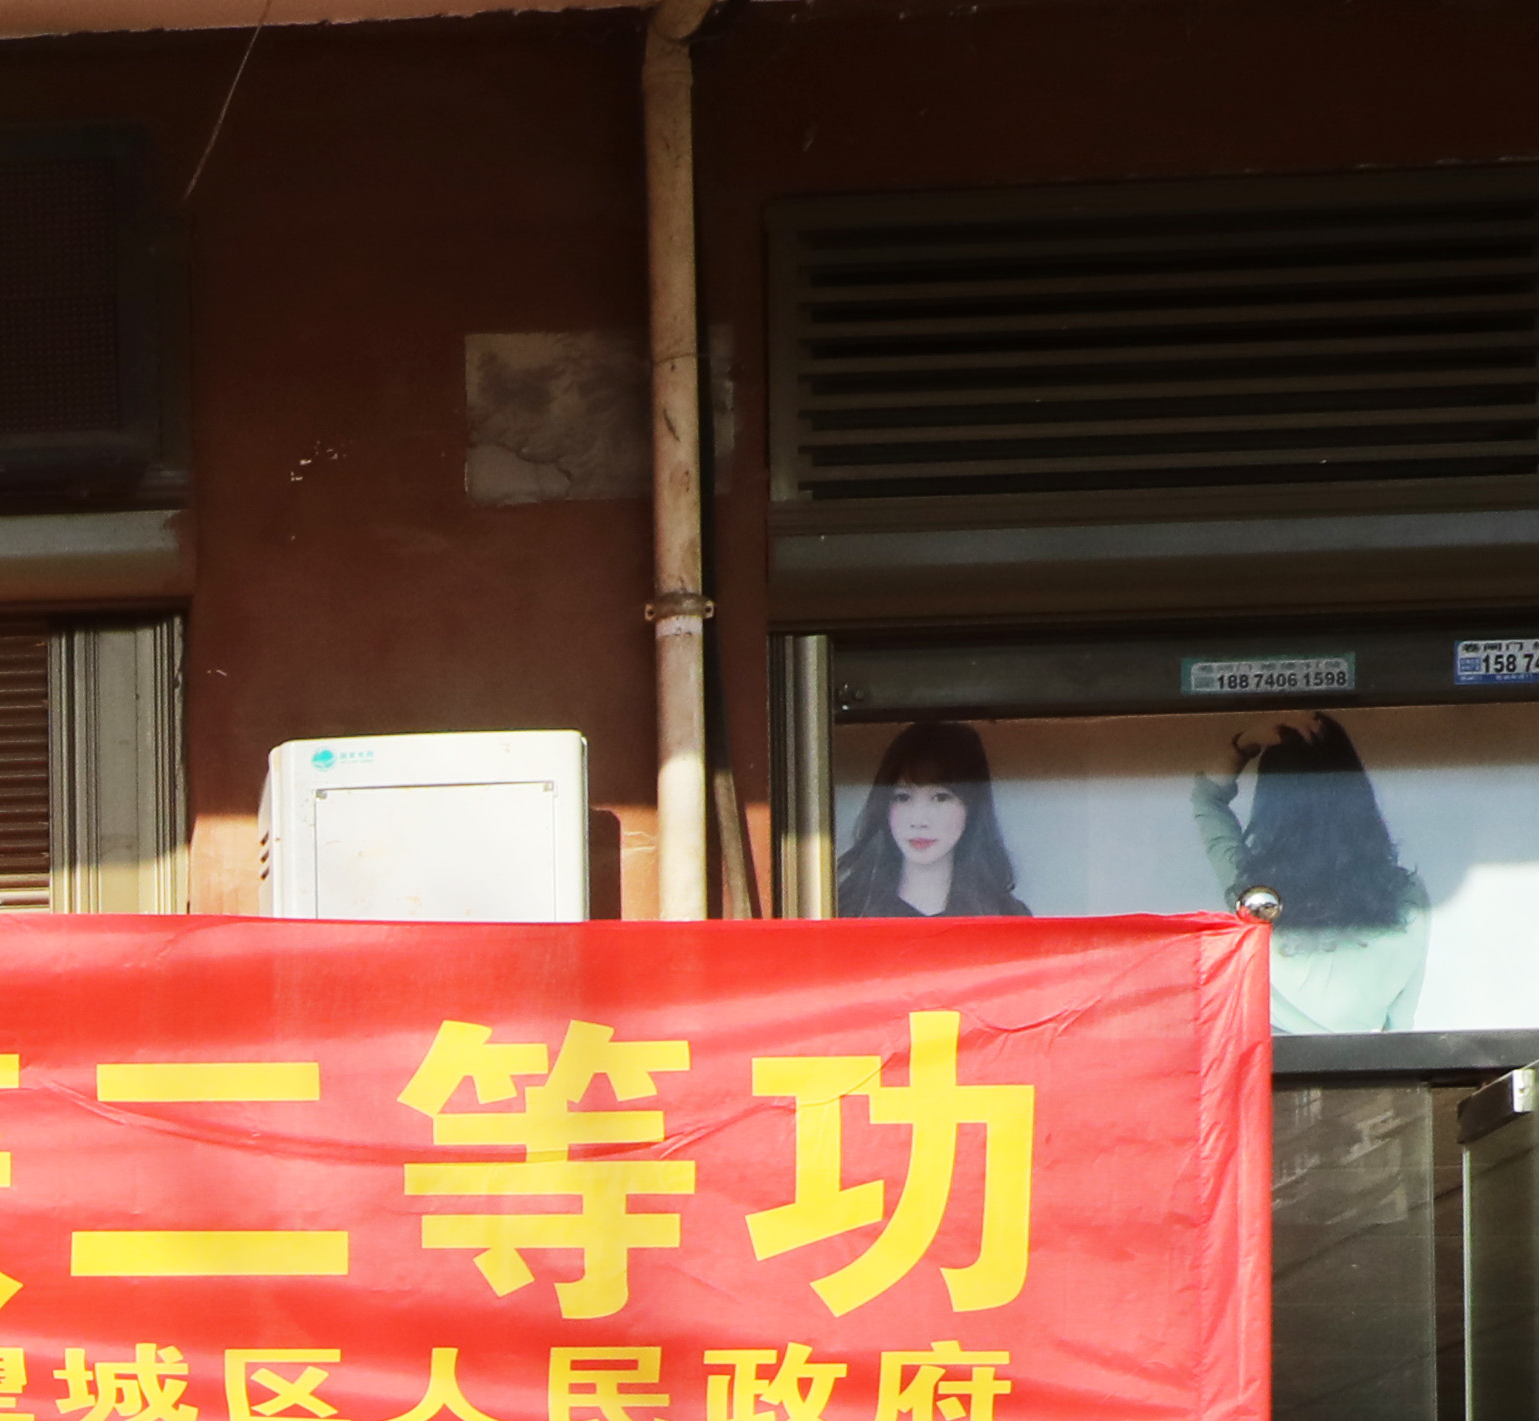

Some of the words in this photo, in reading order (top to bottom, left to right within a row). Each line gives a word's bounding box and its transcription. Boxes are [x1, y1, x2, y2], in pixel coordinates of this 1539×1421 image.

[1482, 654, 1517, 673] 158
[1217, 674, 1249, 690] 188
[1253, 672, 1298, 688] 7406
[1303, 671, 1347, 687] 1598
